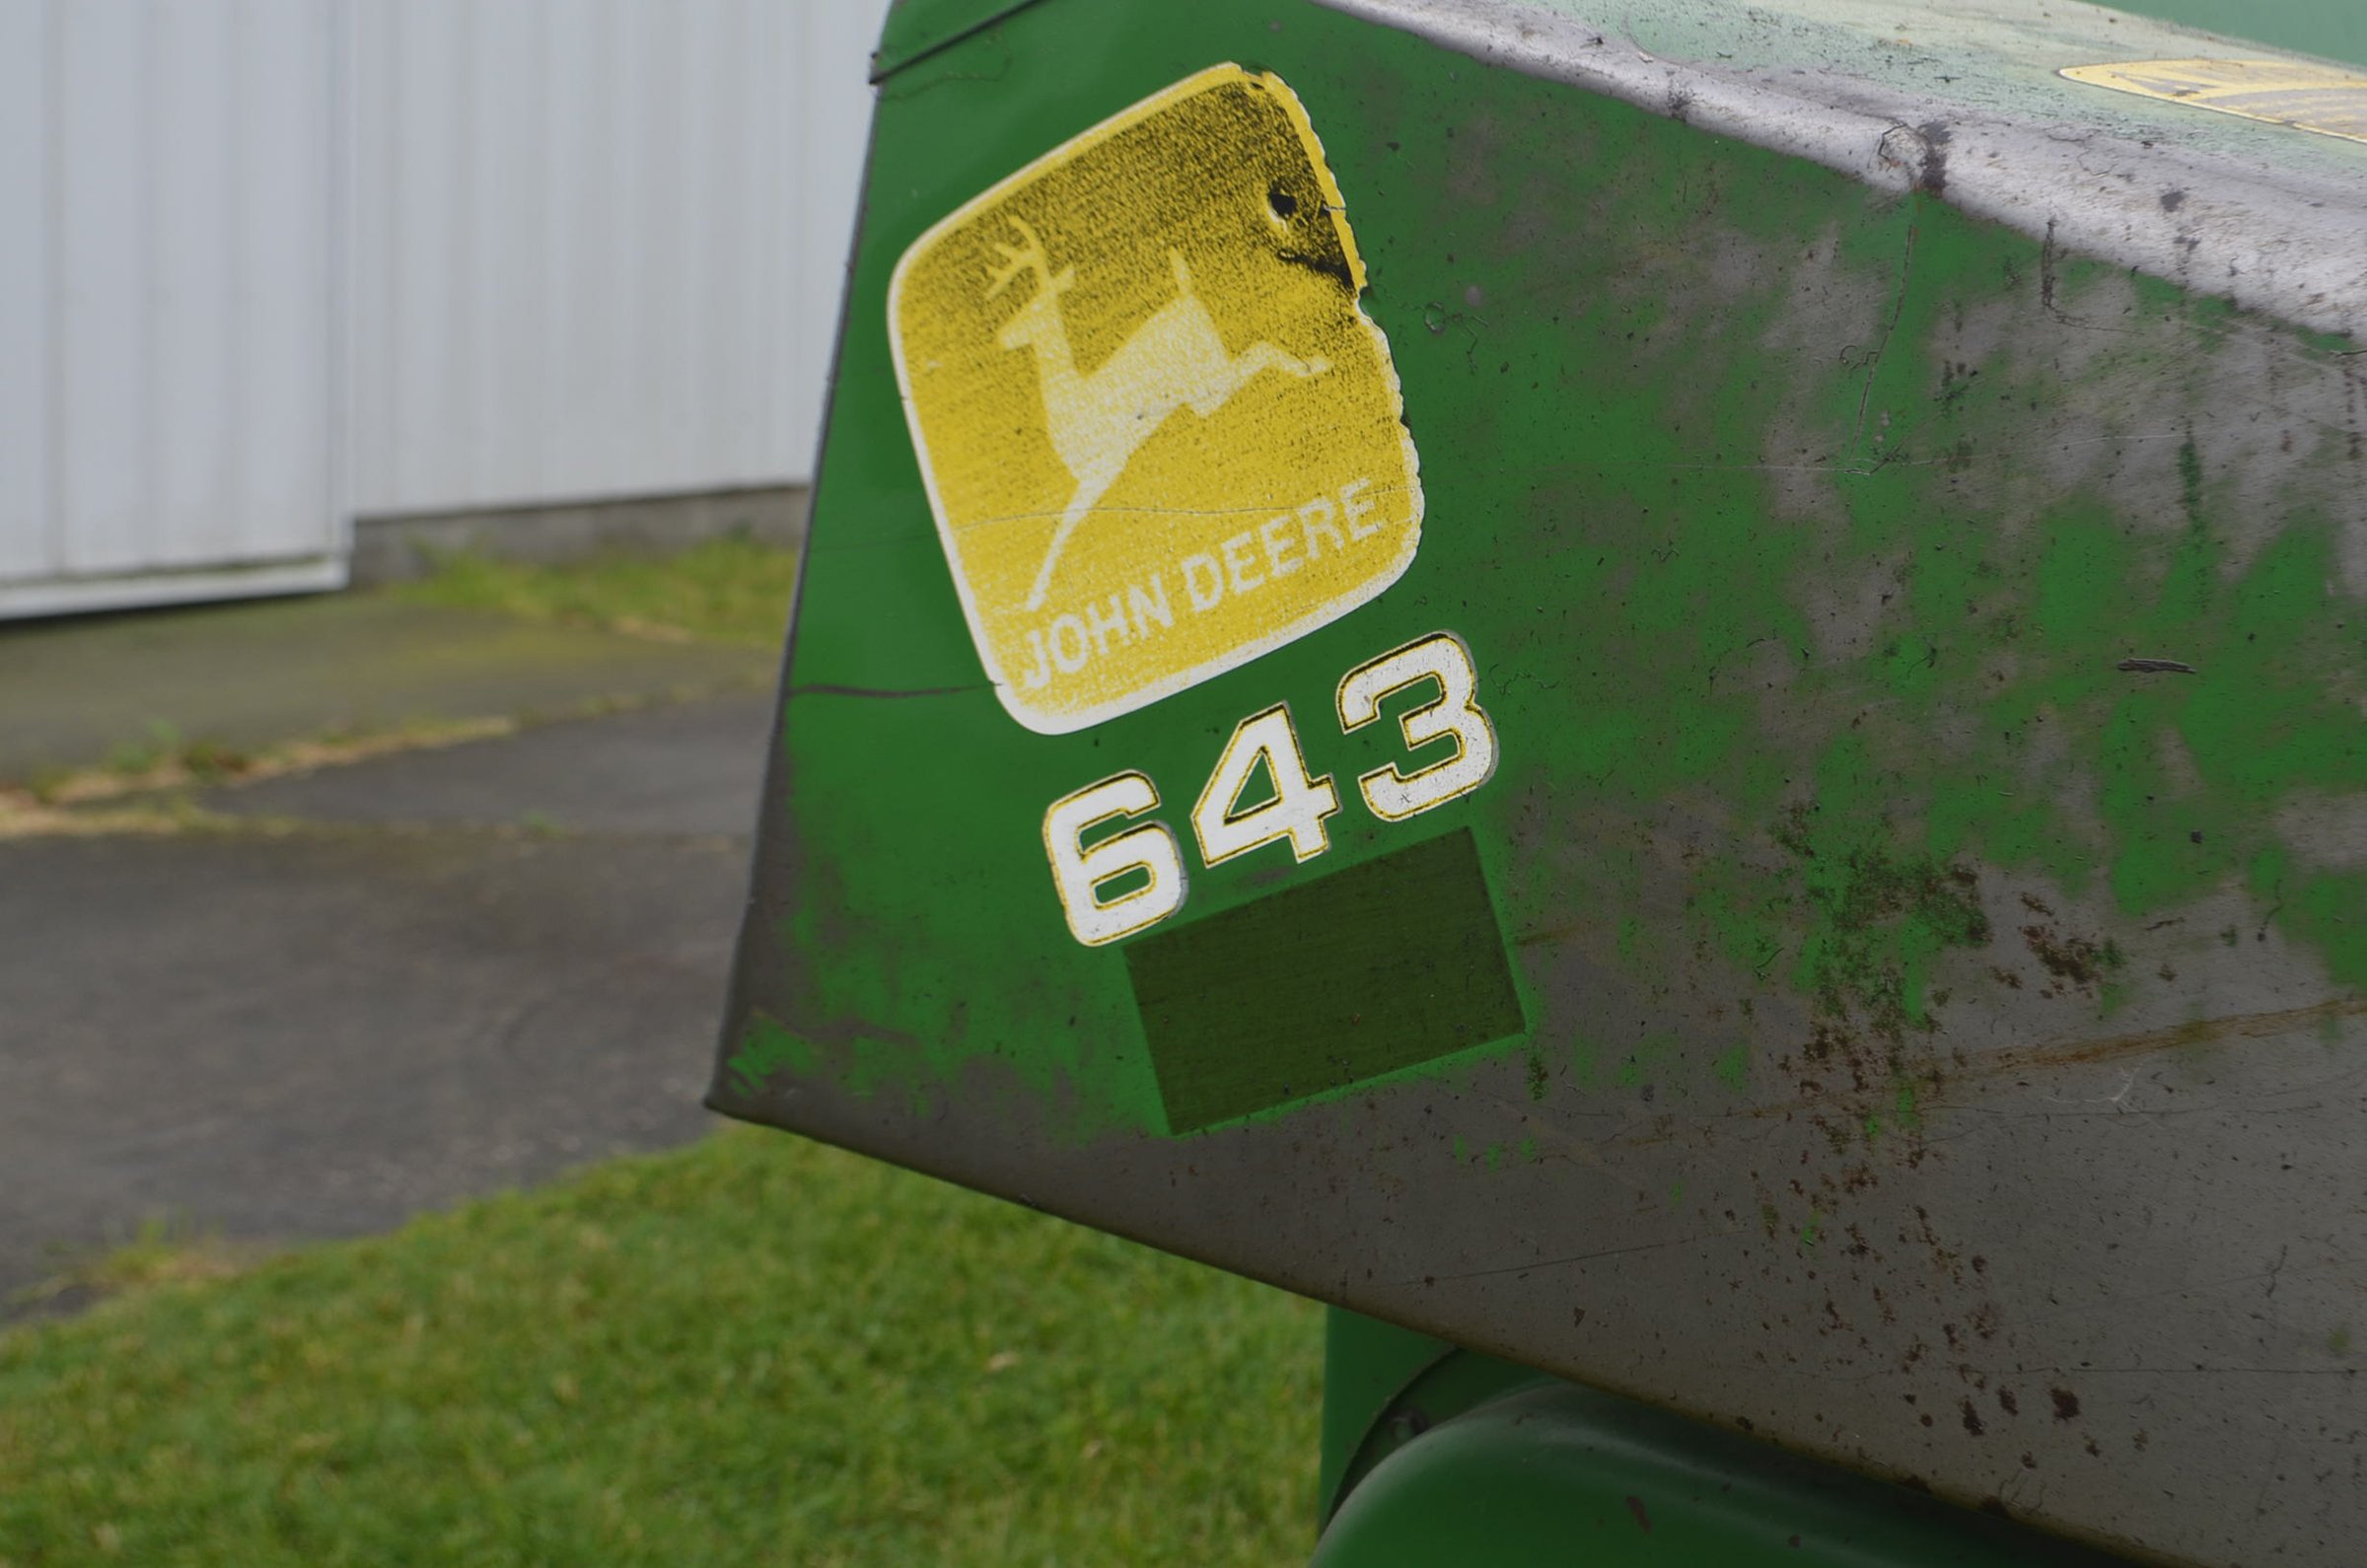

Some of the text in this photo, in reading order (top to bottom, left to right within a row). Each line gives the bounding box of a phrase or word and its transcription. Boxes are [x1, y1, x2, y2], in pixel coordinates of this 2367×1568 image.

[1023, 479, 1385, 690] JOHN DEERE
[1042, 629, 1499, 948] 643
